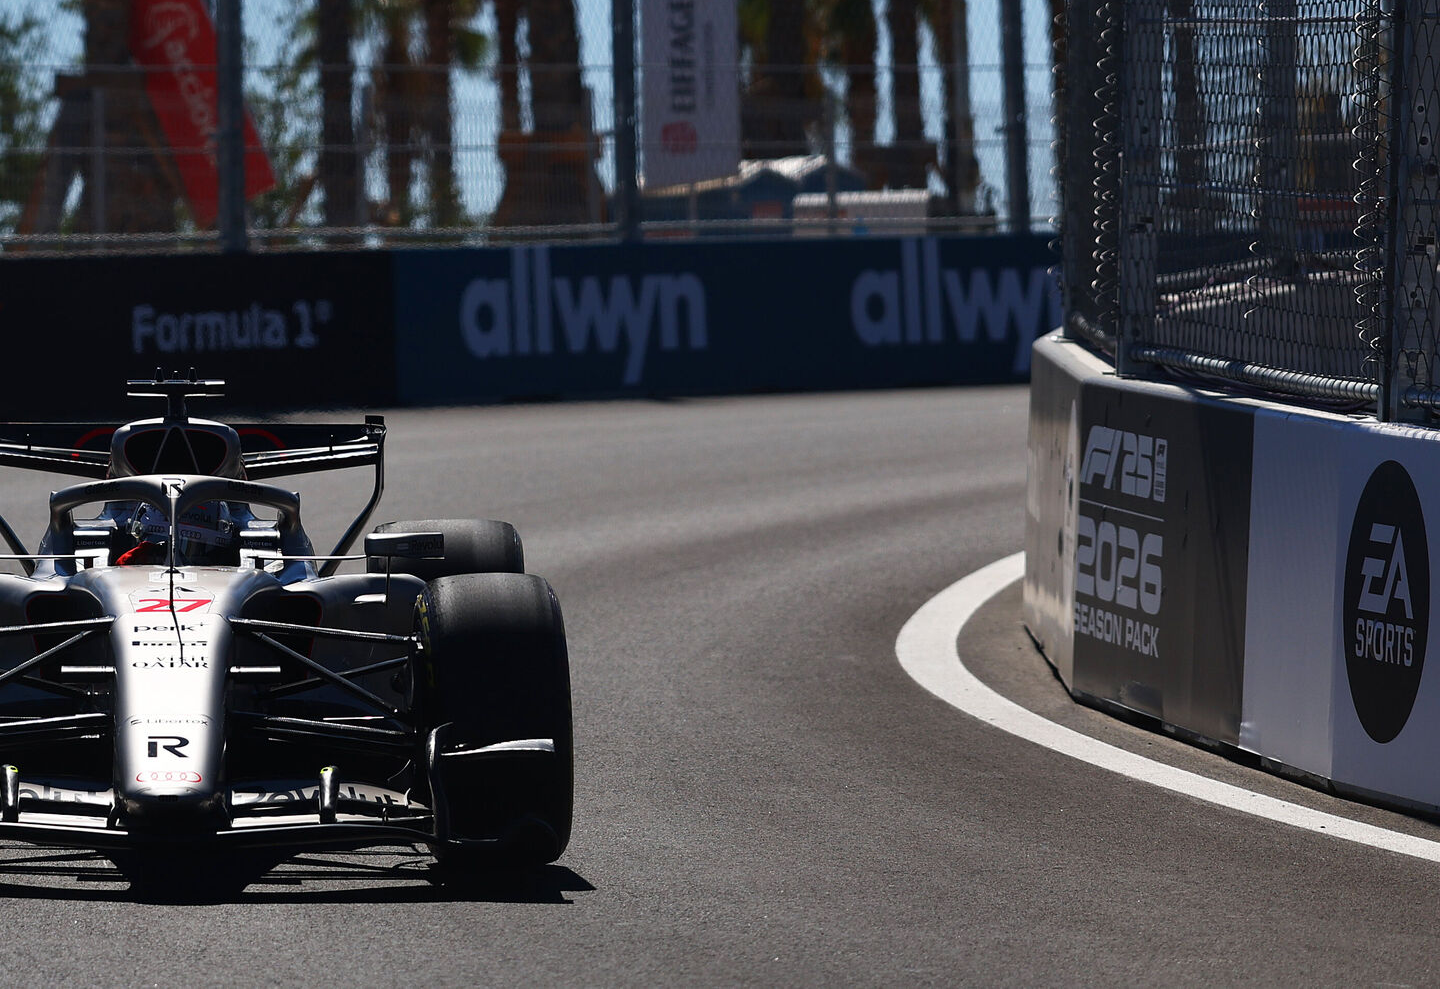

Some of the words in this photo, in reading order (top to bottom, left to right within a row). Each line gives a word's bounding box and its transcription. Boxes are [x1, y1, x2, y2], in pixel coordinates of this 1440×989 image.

[670, 0, 696, 112] EIFFAGE
[132, 303, 287, 353] Formula
[461, 245, 708, 385] allwyn
[850, 234, 1064, 375] allwy
[1121, 431, 1153, 499] 25
[135, 599, 212, 613] 27
[1075, 514, 1164, 616] 2026
[1357, 521, 1414, 620] EA
[1074, 602, 1122, 646] SEASON
[1124, 617, 1160, 659] PACK
[1355, 617, 1414, 668] SPORTS
